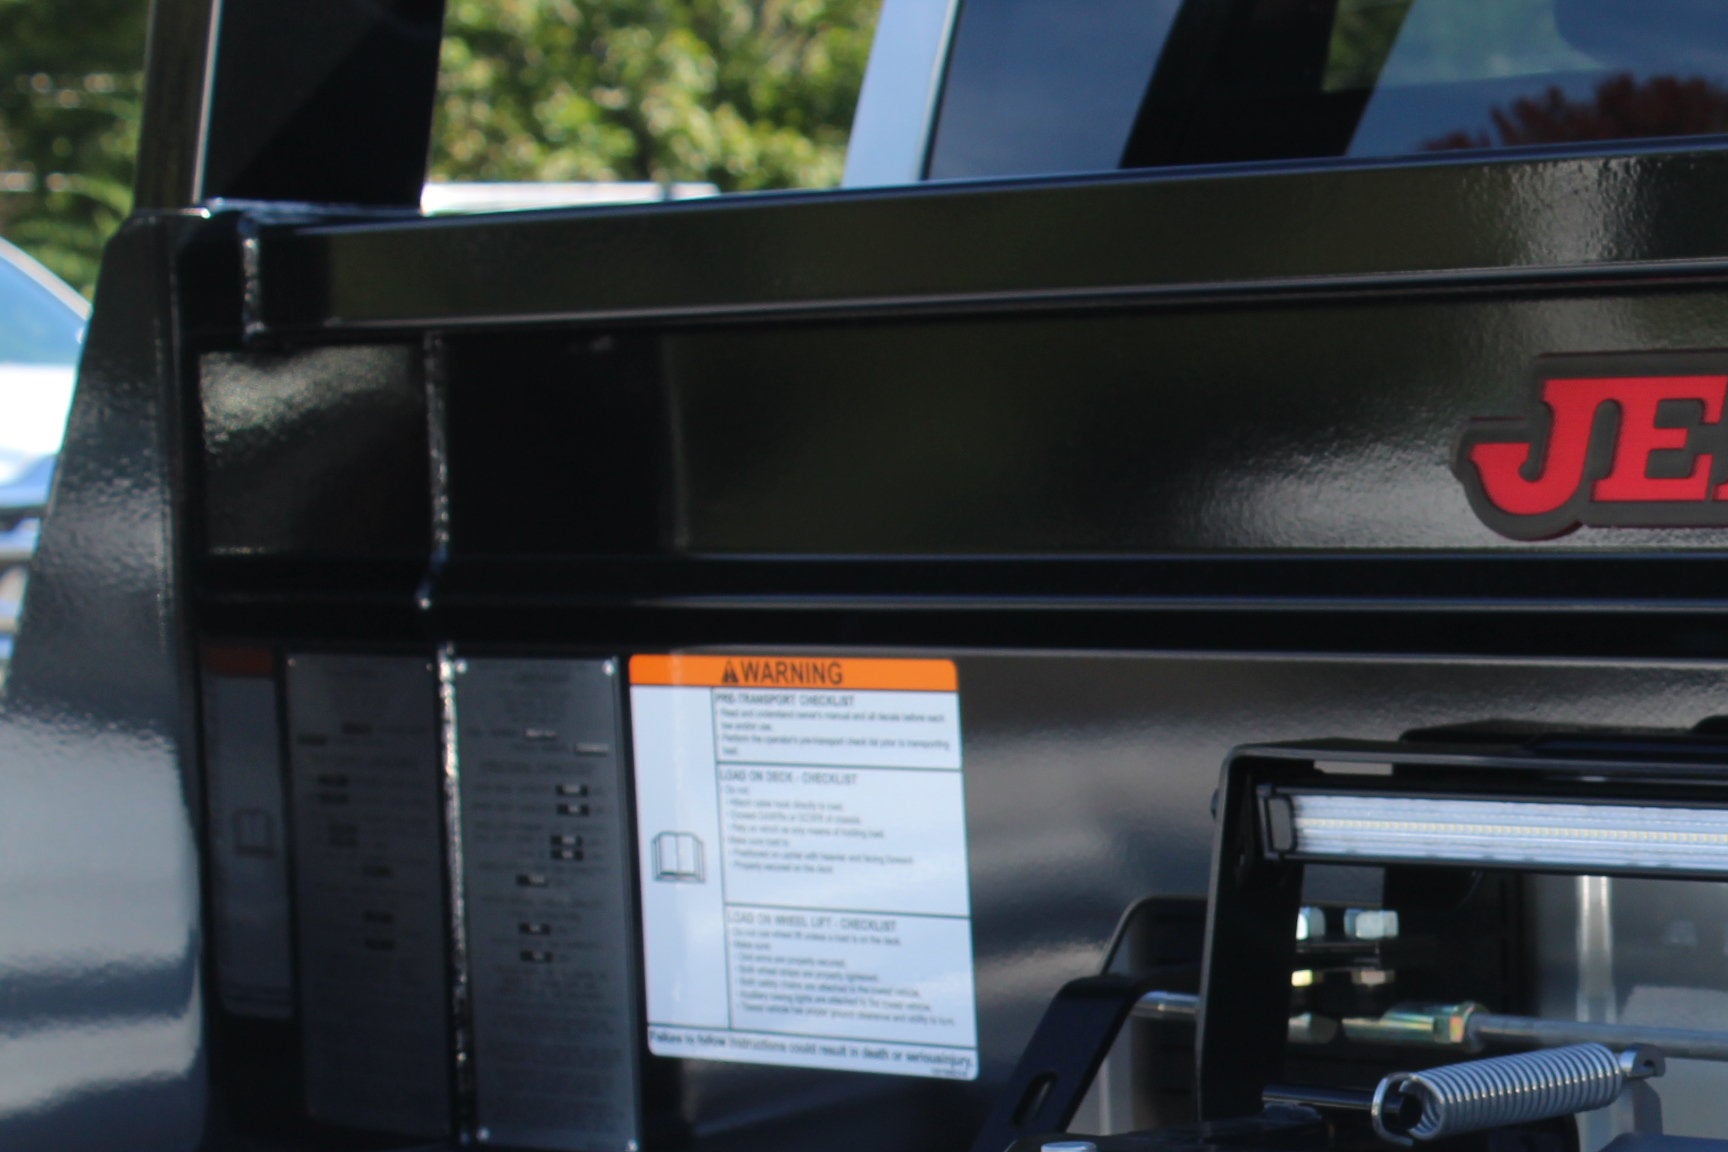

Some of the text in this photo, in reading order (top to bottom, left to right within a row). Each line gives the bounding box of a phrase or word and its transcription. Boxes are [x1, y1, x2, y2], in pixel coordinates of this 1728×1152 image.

[741, 661, 844, 685] WARNING
[798, 694, 855, 707] CHECKLIST
[719, 769, 747, 782] LOAD
[748, 770, 763, 782] ON
[801, 771, 857, 784] CHECKLIST
[727, 911, 754, 924] LOAD
[755, 912, 771, 925] ON
[775, 914, 808, 926] WHEEL
[840, 917, 896, 931] CHECKLIST
